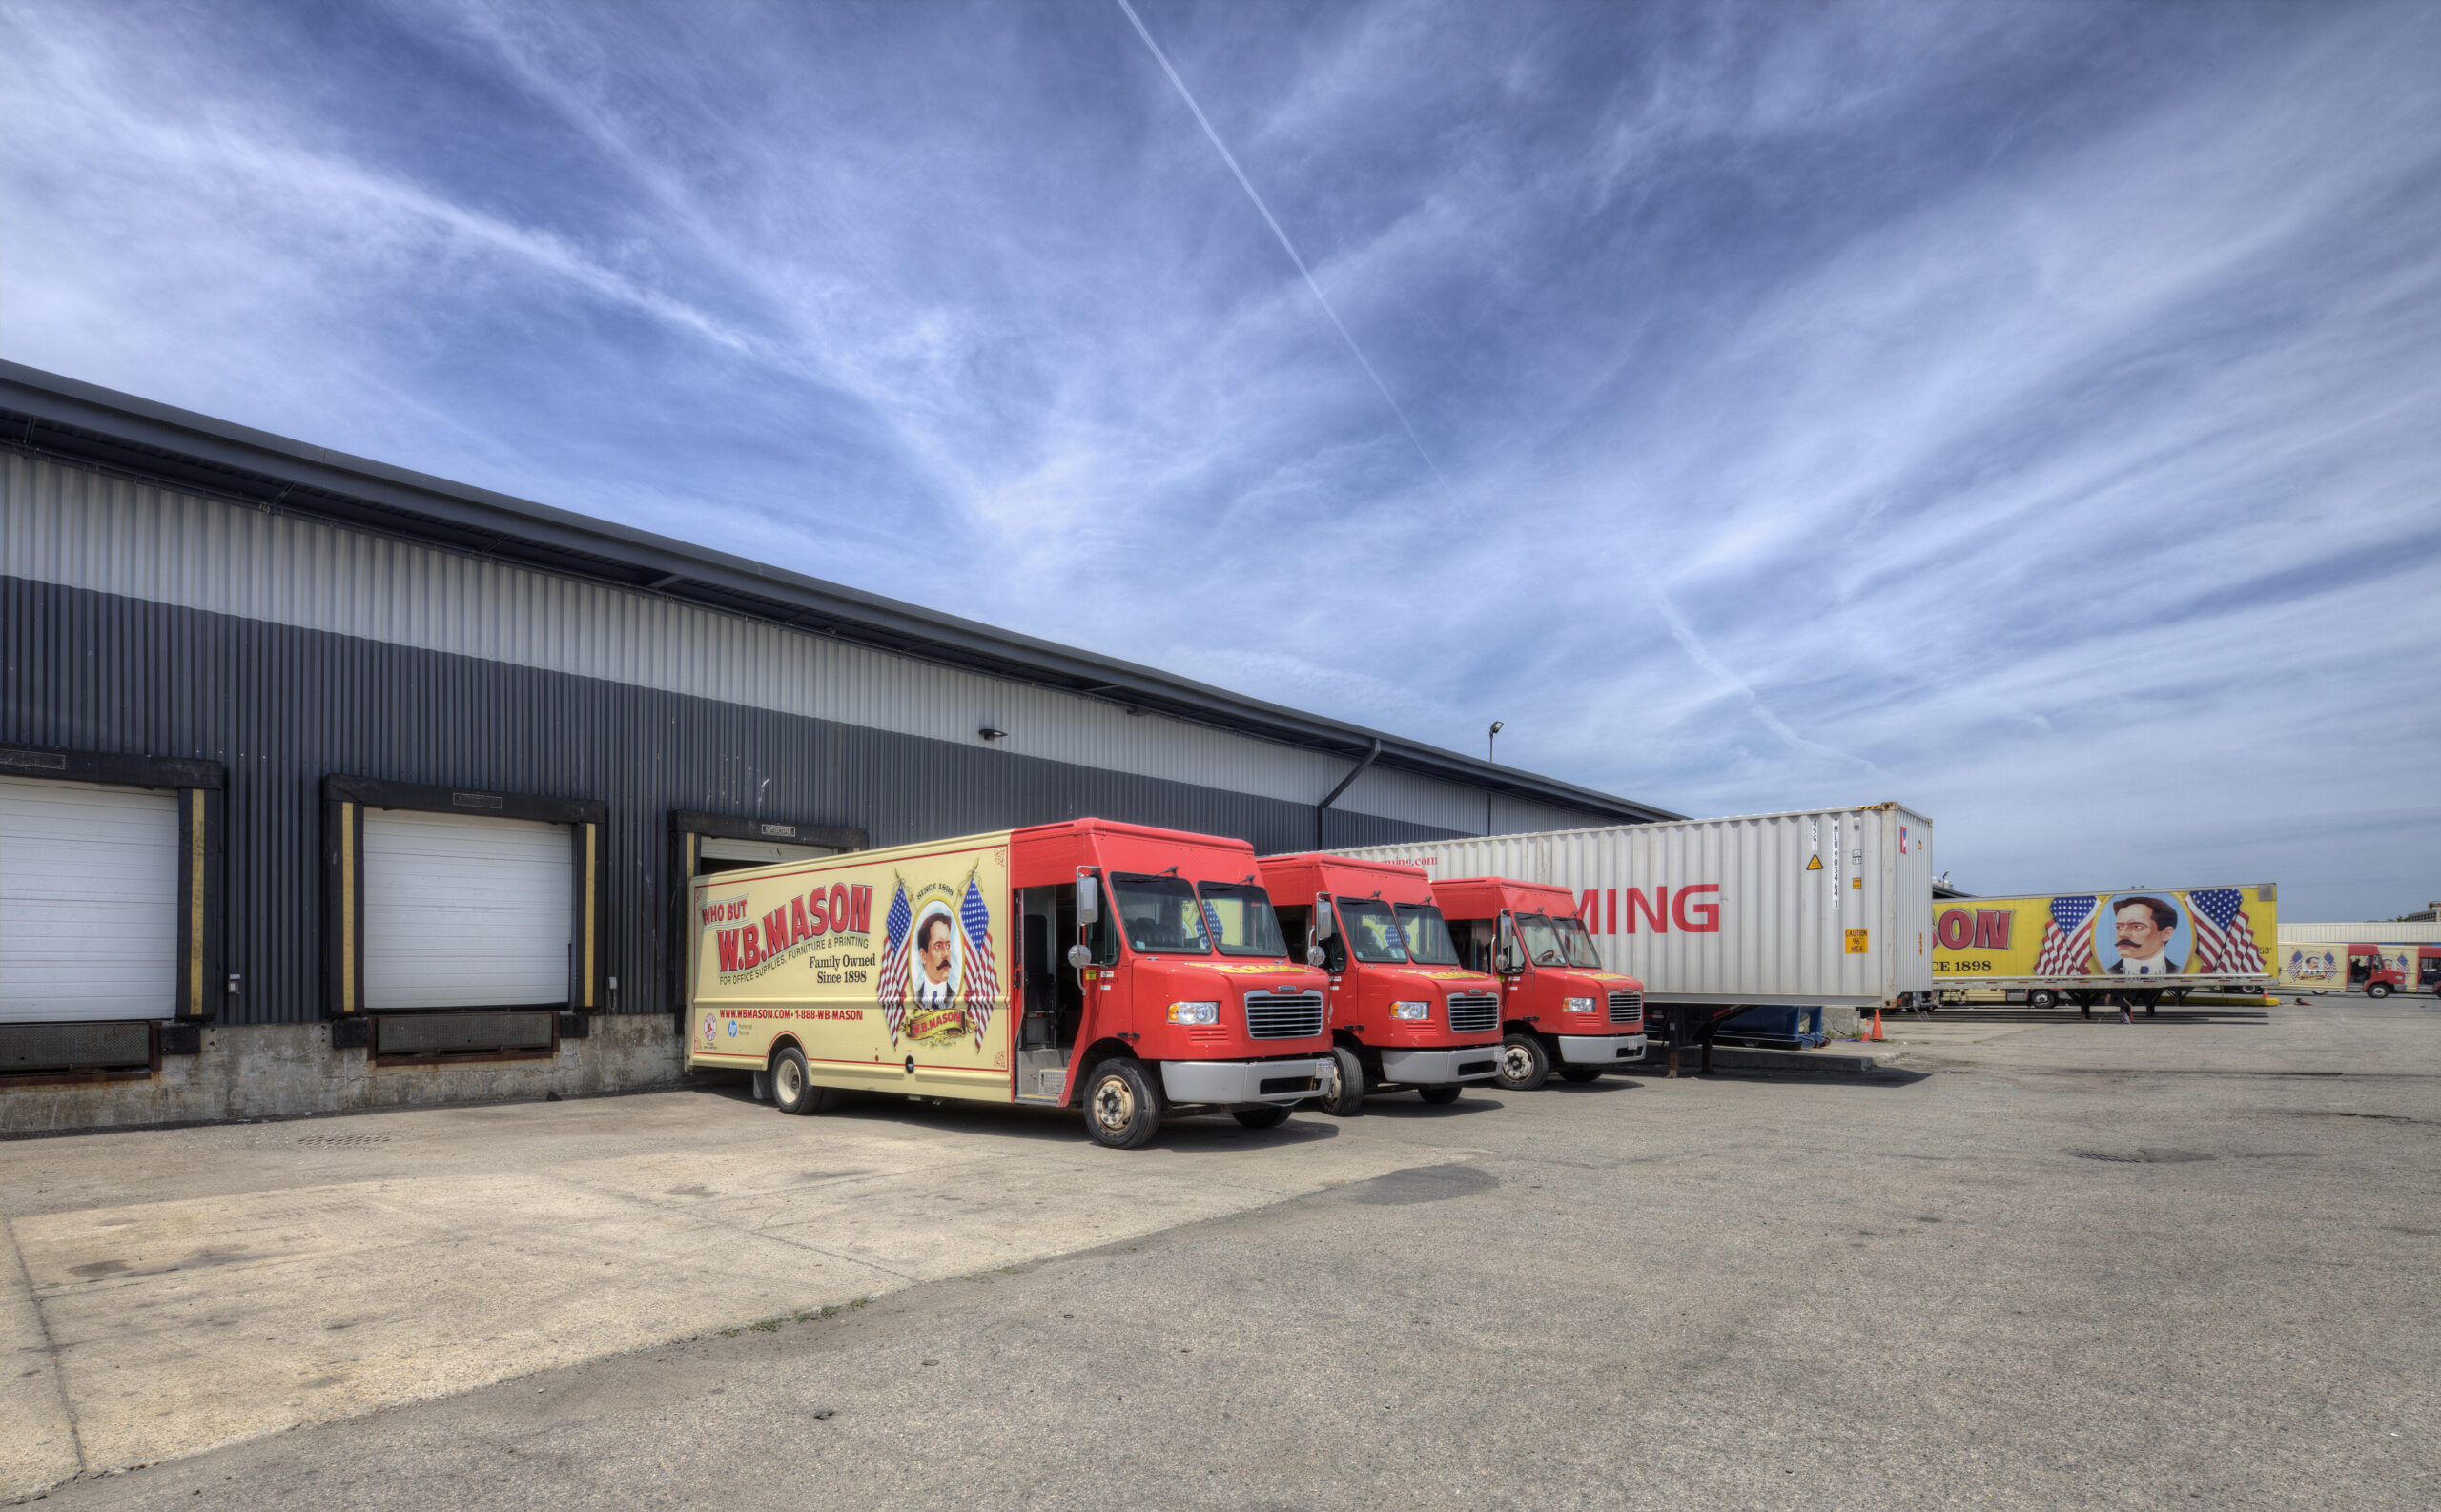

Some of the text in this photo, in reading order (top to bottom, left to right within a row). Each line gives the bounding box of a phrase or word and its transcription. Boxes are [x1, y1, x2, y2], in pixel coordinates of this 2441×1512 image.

[917, 883, 954, 900] SINCE 1898
[702, 899, 748, 925] WHO BUT
[719, 936, 869, 986] FOR OFFICE SUPPLIES, FURNITURE & PRINTING
[810, 953, 876, 971] Family Owned
[1955, 961, 1992, 971] 1898
[817, 971, 867, 984] Since 1898
[719, 1009, 863, 1020] WWW.WBMASON.COM 1-888-WB-MASON
